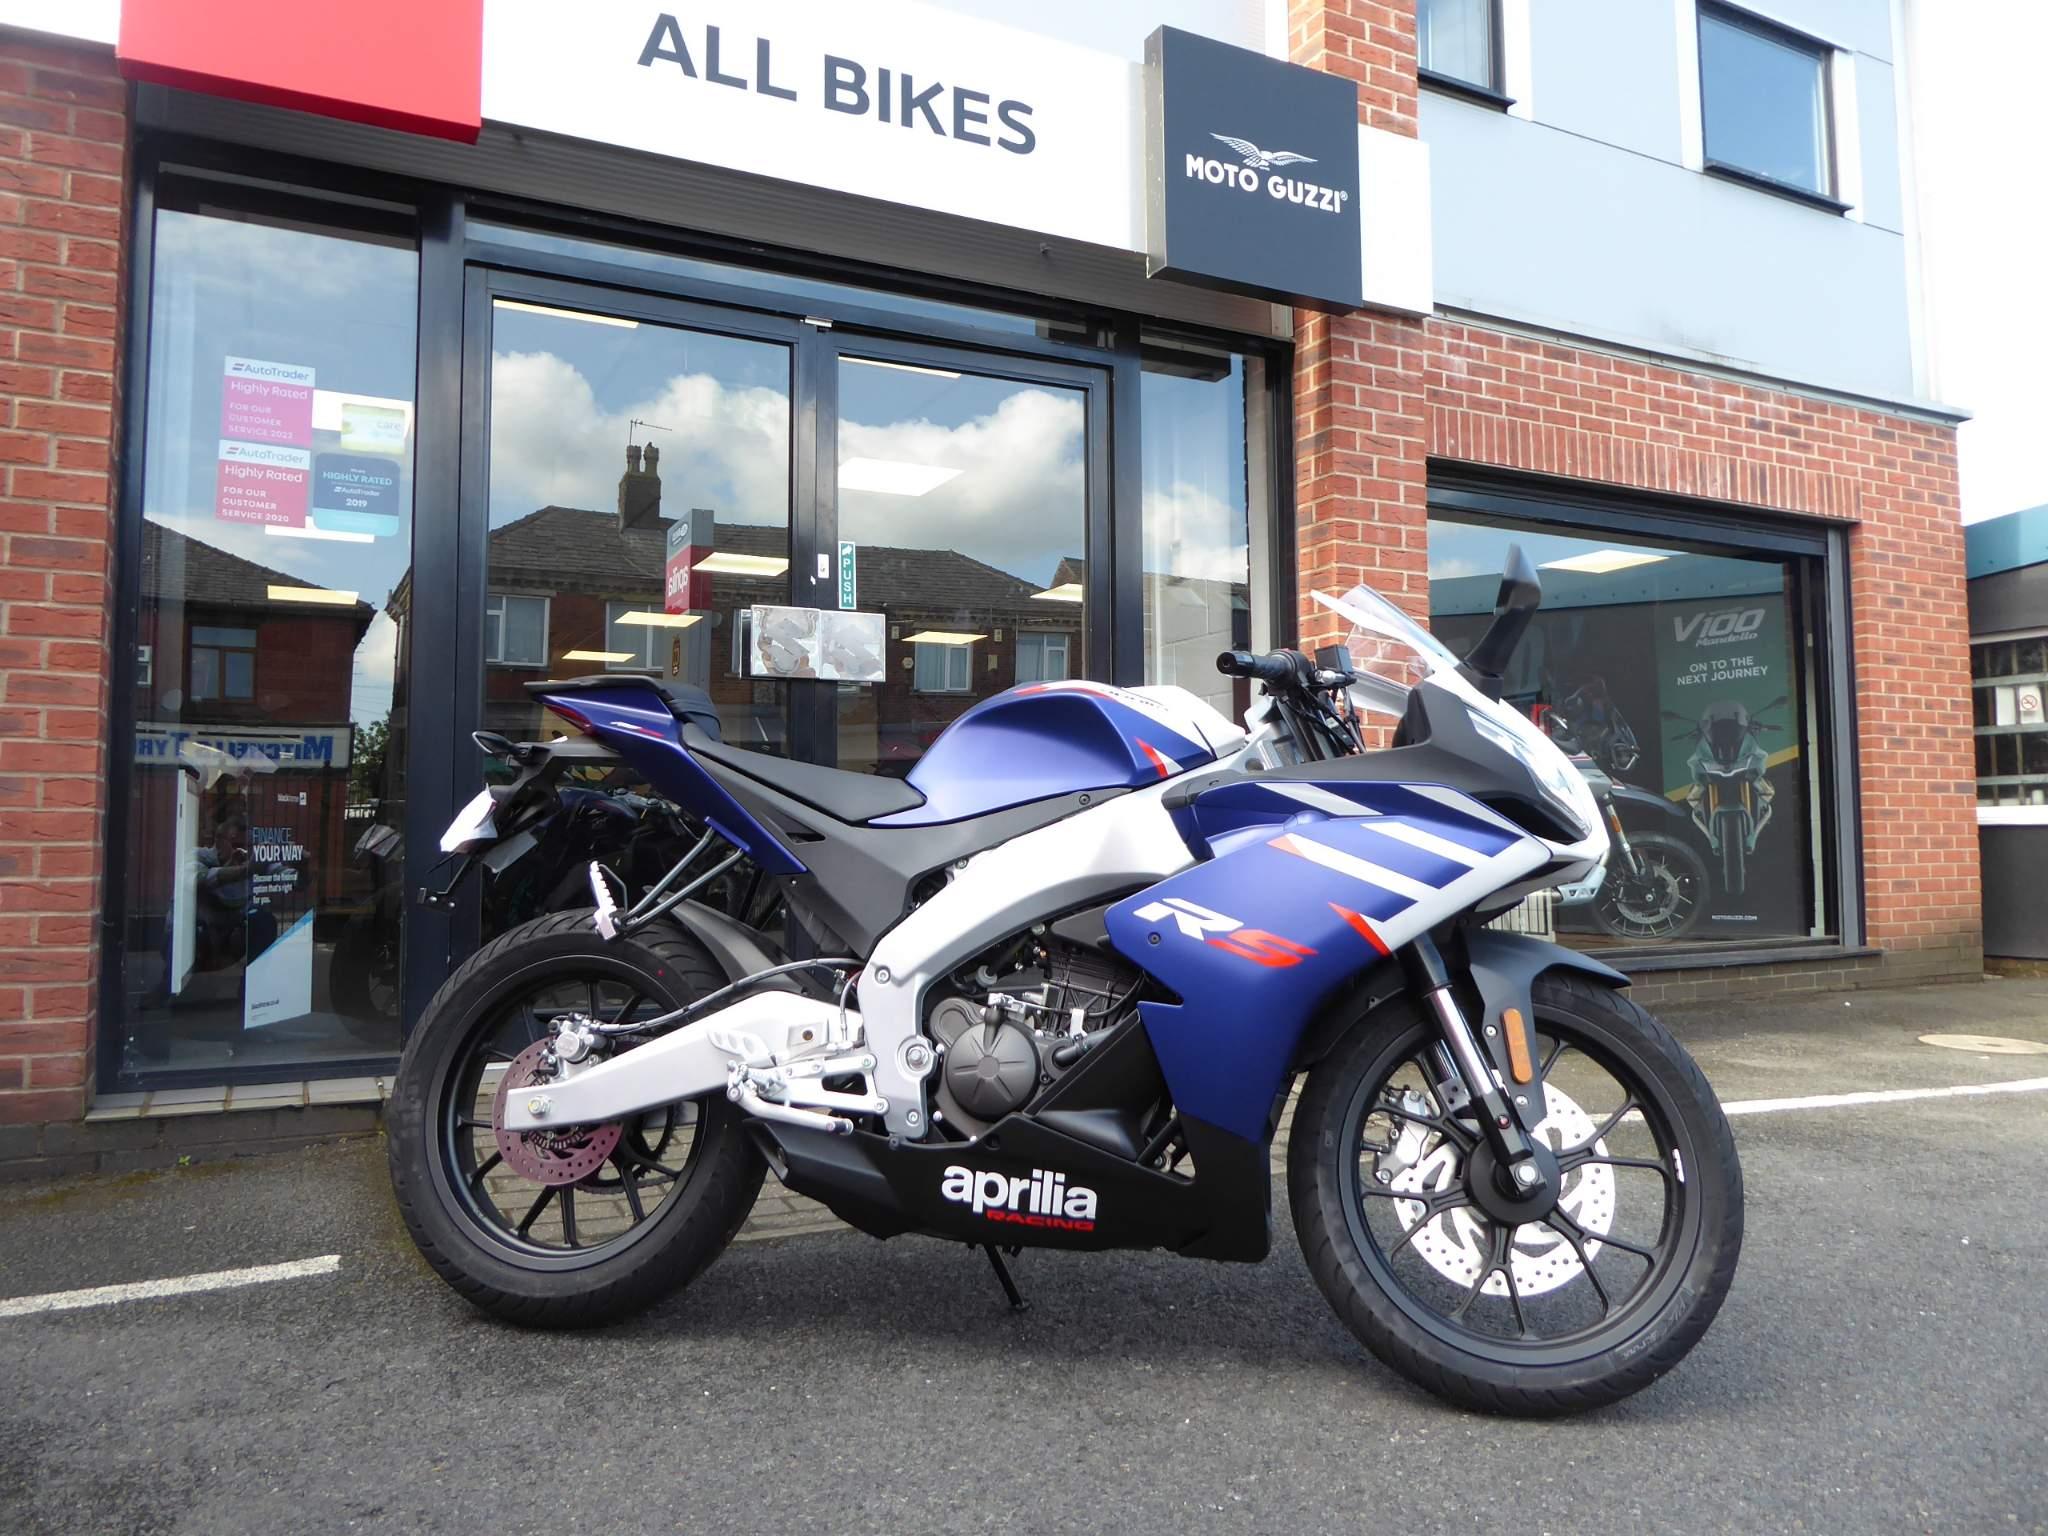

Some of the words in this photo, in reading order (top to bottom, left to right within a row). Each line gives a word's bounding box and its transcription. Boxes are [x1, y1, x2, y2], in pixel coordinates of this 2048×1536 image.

[637, 12, 797, 102] ALL
[823, 54, 1037, 155] BIKES
[1186, 153, 1259, 192] MOTO
[244, 364, 309, 381] AutoTrader
[231, 381, 270, 397] Highly
[272, 386, 308, 400] Rated
[229, 402, 249, 411] FOR
[251, 404, 272, 414] OUR
[229, 414, 282, 427] CUSTOMER
[238, 447, 304, 464] AutoTrader
[224, 465, 264, 481] Highly
[266, 469, 303, 483] Rated
[323, 472, 360, 483] HIGHLY
[361, 475, 393, 486] RATED
[223, 486, 244, 497] FOR
[246, 488, 267, 498] OUR
[223, 498, 277, 511] CUSTOMER
[346, 498, 368, 508] 2019
[222, 509, 262, 521] SERVICE
[265, 512, 289, 523] 2020
[842, 559, 852, 604] PUSH
[1673, 608, 1766, 642] V100
[1689, 662, 1707, 673] ON
[1710, 659, 1727, 670] TO
[1730, 656, 1754, 667] THE
[1676, 673, 1707, 685] NEXT
[1711, 665, 1768, 681] JOURNEY
[253, 827, 294, 844] FINANCE
[253, 844, 280, 862] YOUR
[281, 844, 304, 861] WAY
[1133, 898, 1319, 968] RS
[941, 1165, 1098, 1220] aprilia
[986, 1209, 1095, 1232] RACING
